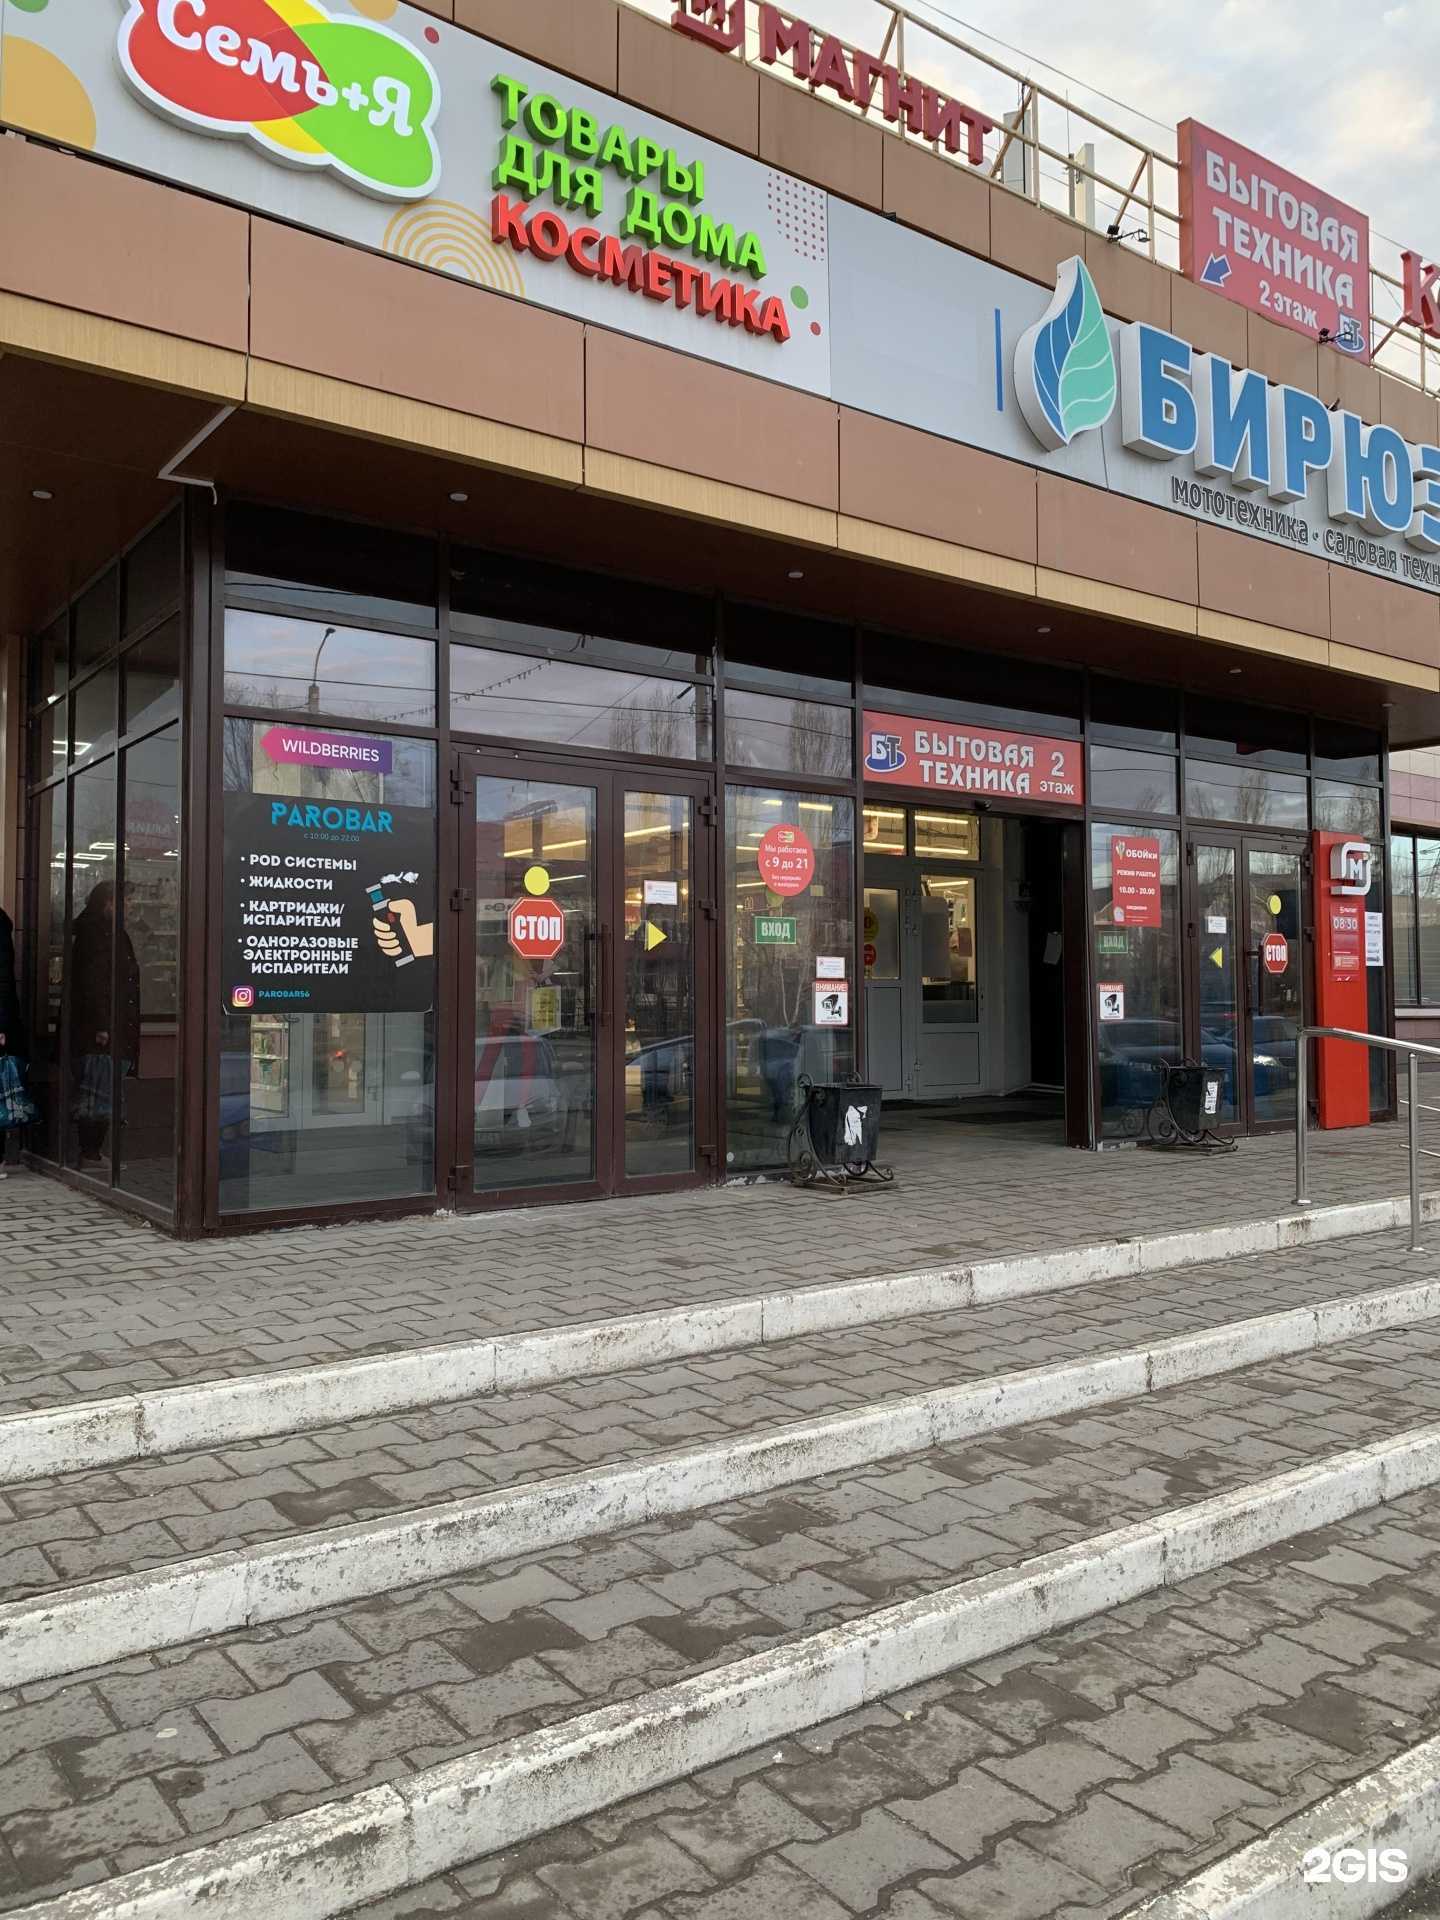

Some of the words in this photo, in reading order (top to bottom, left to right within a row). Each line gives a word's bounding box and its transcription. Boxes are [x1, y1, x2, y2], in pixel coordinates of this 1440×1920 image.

[157, 0, 413, 136] Семь+Я
[758, 2, 993, 166] МАГНИТ
[490, 73, 704, 205] ТОВАРЫ
[492, 133, 603, 218] ДЛЯ
[620, 186, 767, 280] ДОМА
[1206, 149, 1358, 263] БЫТОВАЯ
[491, 194, 790, 343] КОСМЕТИКА
[1212, 206, 1353, 310] ТЕХНИКА
[1259, 280, 1271, 308] 2
[1273, 293, 1318, 330] этаж
[1172, 476, 1309, 545] мототехника
[1323, 528, 1398, 574] садовая
[282, 738, 380, 763] WILDBERRIES
[871, 733, 902, 767] БТ
[914, 730, 1034, 768] БЫТОВАЯ
[919, 759, 1030, 795] ТЕХНИКА
[1051, 751, 1065, 777] 2
[1039, 779, 1075, 795] этаж
[271, 802, 392, 833] PAROBAR
[250, 854, 279, 867] POD
[284, 856, 357, 871] СИСТЕМЫ
[765, 859, 771, 867] с
[772, 856, 780, 868] 9
[781, 860, 793, 870] до
[796, 857, 808, 869] 21
[1126, 848, 1158, 860] ОБОЙки
[249, 876, 333, 890] ЖИДКОСТИ
[243, 914, 341, 928] ИСПАРИТЕЛИ
[249, 901, 344, 915] КАРТРИДЖИ/
[515, 915, 561, 941] СТОП
[761, 922, 790, 939] ВХОД
[243, 949, 353, 962] ЭЛЕКТРОННЫЕ
[246, 936, 359, 949] ОДНОРАЗОВЫЕ
[1265, 944, 1287, 962] СТОП
[251, 963, 349, 975] ИСПАРИТЕЛИ
